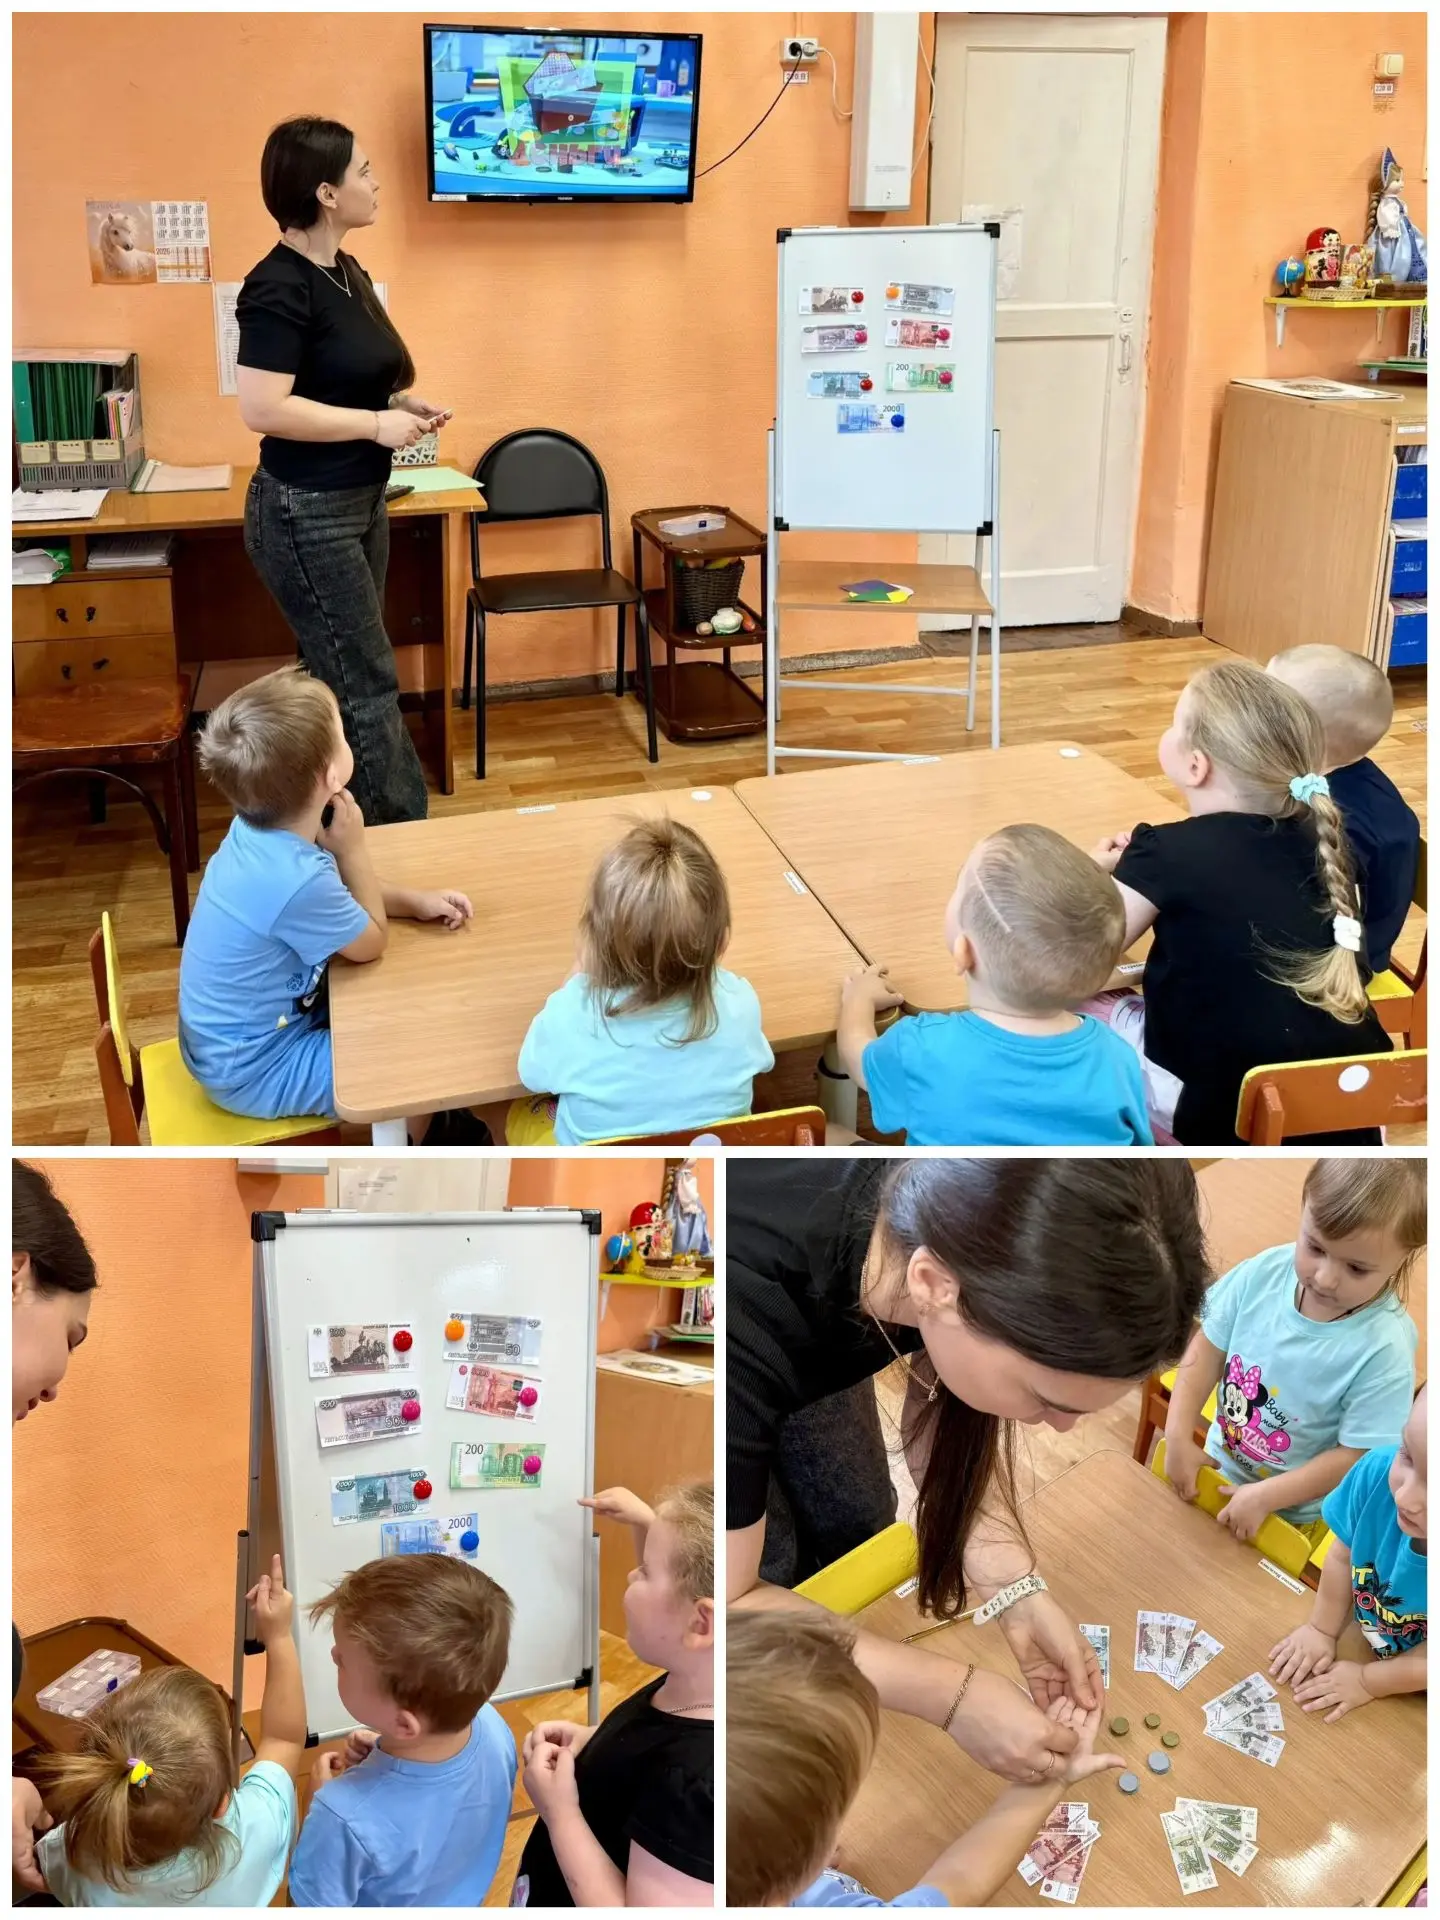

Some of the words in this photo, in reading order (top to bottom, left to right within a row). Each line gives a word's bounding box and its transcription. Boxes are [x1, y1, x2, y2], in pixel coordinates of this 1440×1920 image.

[895, 363, 910, 371] 200
[882, 405, 901, 413] 2000
[505, 1343, 521, 1356] 50
[320, 1400, 336, 1409] 500
[1264, 1397, 1290, 1427] Baby
[465, 1443, 484, 1455] 200
[393, 1501, 418, 1514] 1000
[448, 1517, 473, 1530] 2000
